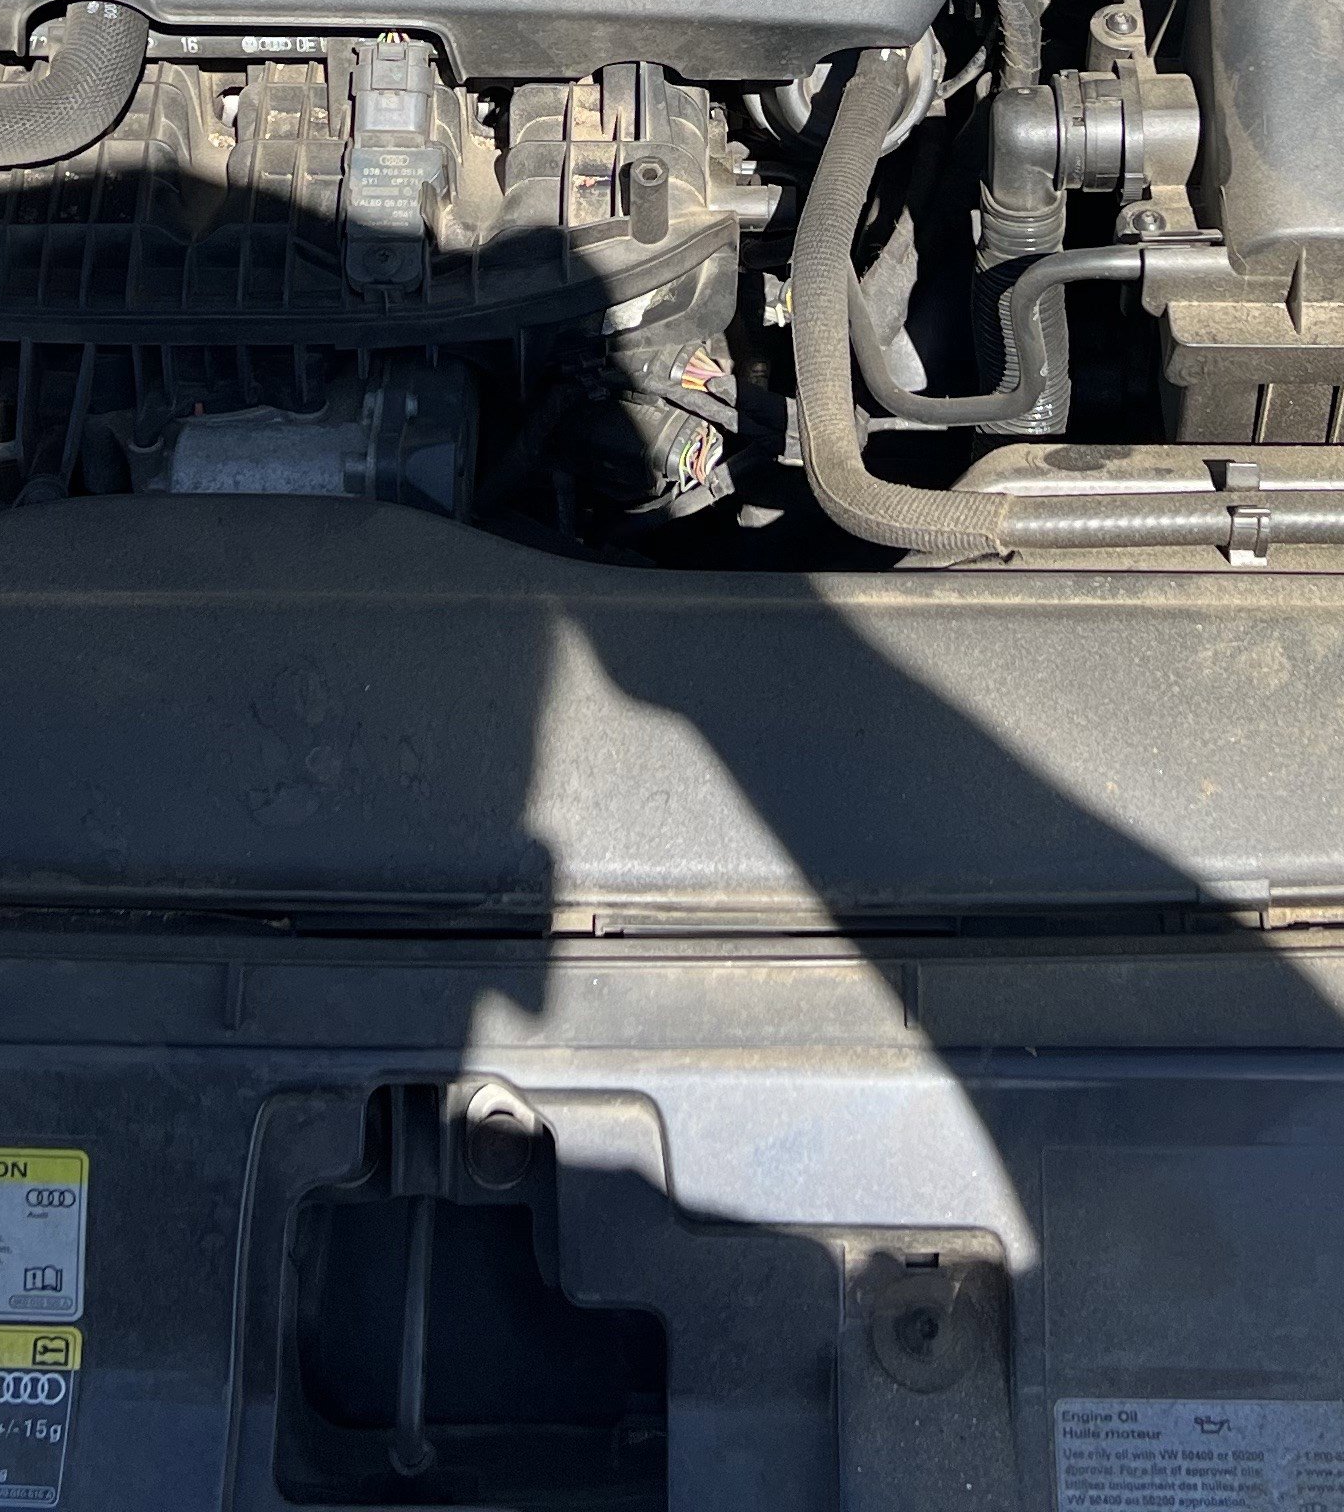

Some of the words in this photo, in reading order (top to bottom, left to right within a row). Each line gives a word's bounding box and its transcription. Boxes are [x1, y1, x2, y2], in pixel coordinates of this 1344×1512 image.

[181, 37, 198, 53] 16
[1062, 1411, 1112, 1424] Engine
[1118, 1410, 1138, 1423] Oil
[1063, 1427, 1100, 1439] Huile
[1105, 1429, 1162, 1440] moteur
[1159, 1450, 1178, 1460] VW
[1067, 1495, 1086, 1505] VW
